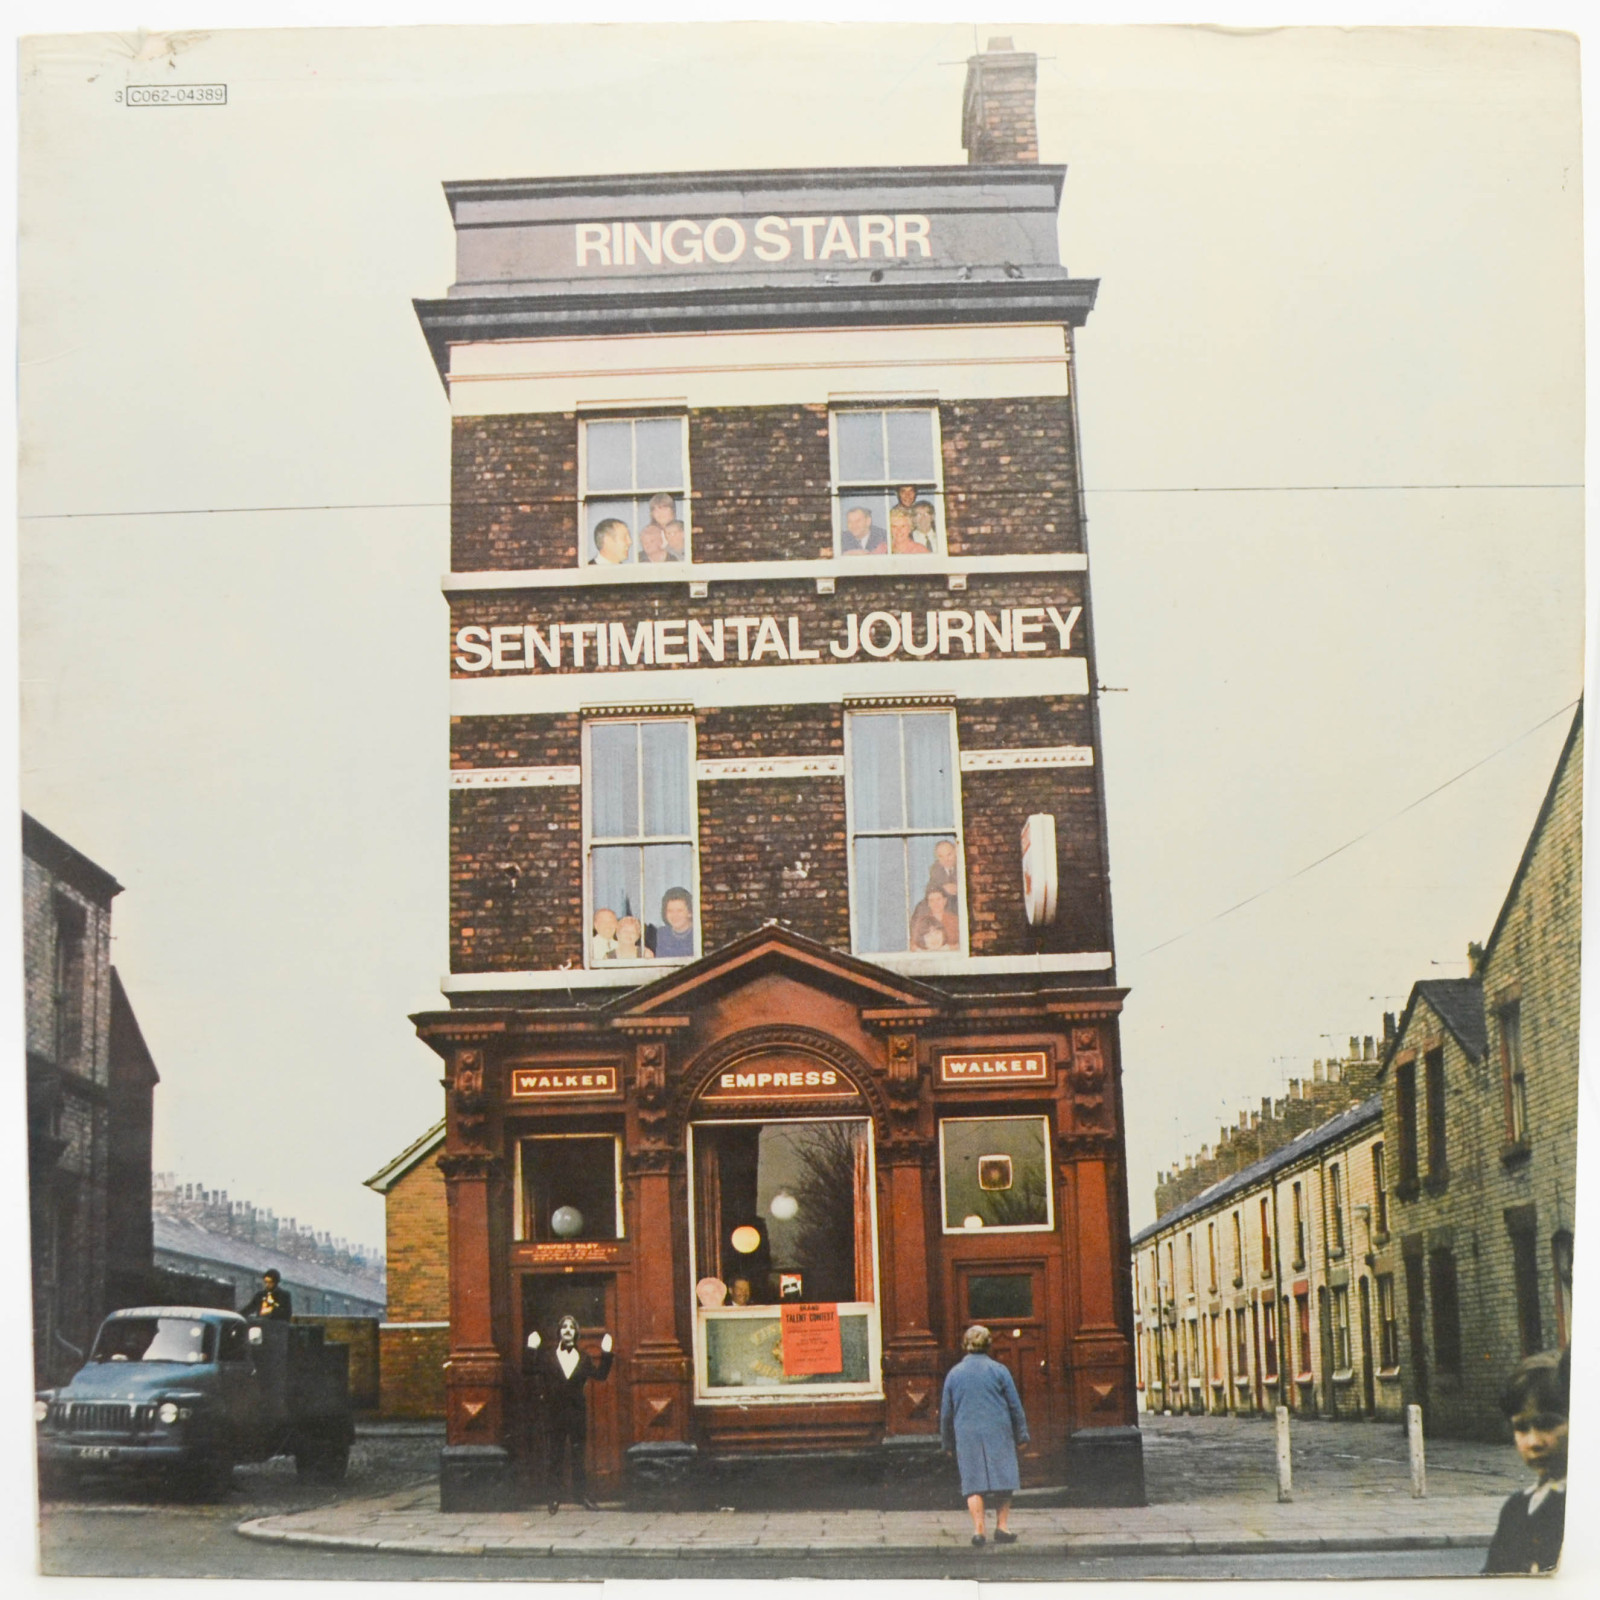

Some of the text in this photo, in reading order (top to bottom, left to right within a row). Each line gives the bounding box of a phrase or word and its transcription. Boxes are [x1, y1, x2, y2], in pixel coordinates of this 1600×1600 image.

[114, 88, 223, 103] 3 C062-04389
[575, 213, 932, 267] RINGO STARR
[454, 606, 1082, 672] SENTIMENTAL JOURNEY
[949, 1060, 1038, 1074] WALKER
[519, 1074, 609, 1088] WALKER
[719, 1071, 838, 1089] EMPRESS
[785, 1312, 834, 1324] TALENT CONTEST
